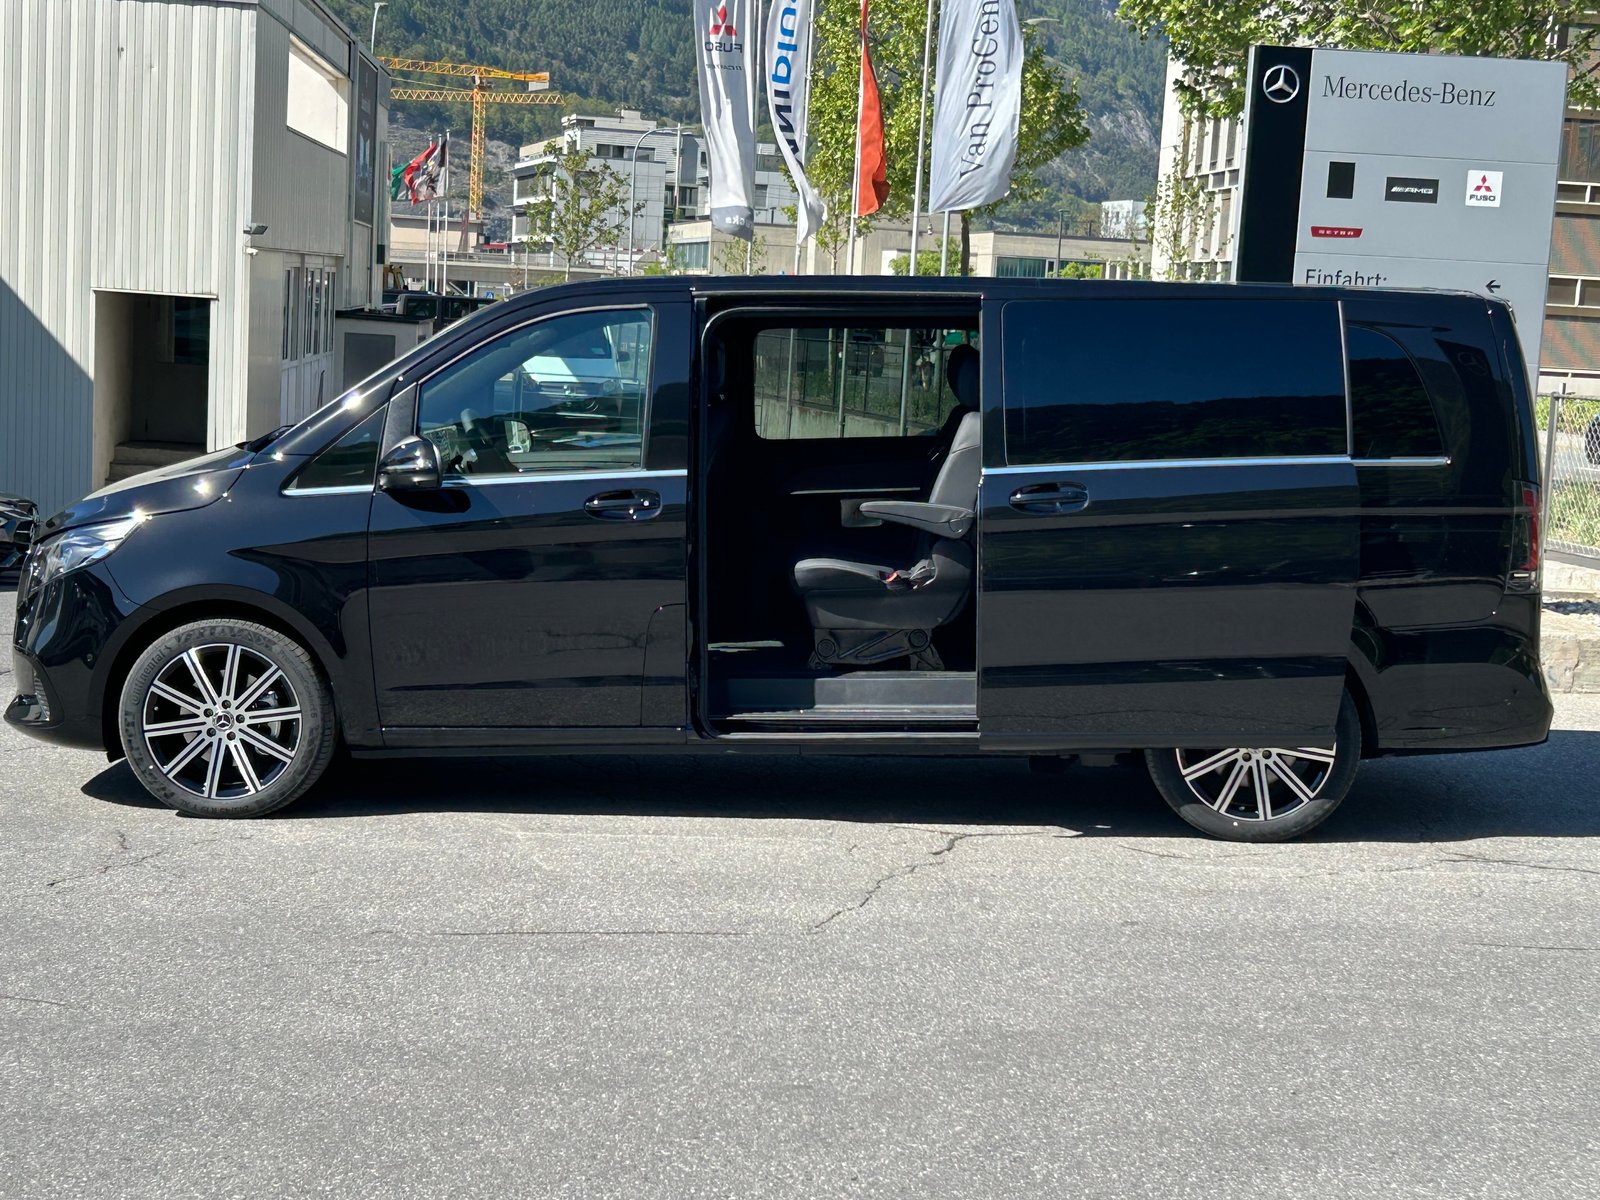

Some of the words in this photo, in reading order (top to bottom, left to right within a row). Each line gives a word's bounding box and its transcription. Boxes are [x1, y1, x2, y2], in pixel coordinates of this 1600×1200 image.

[1322, 75, 1496, 107] Mercedes-Benz
[960, 118, 991, 180] Van
[1469, 193, 1496, 202] FUSO
